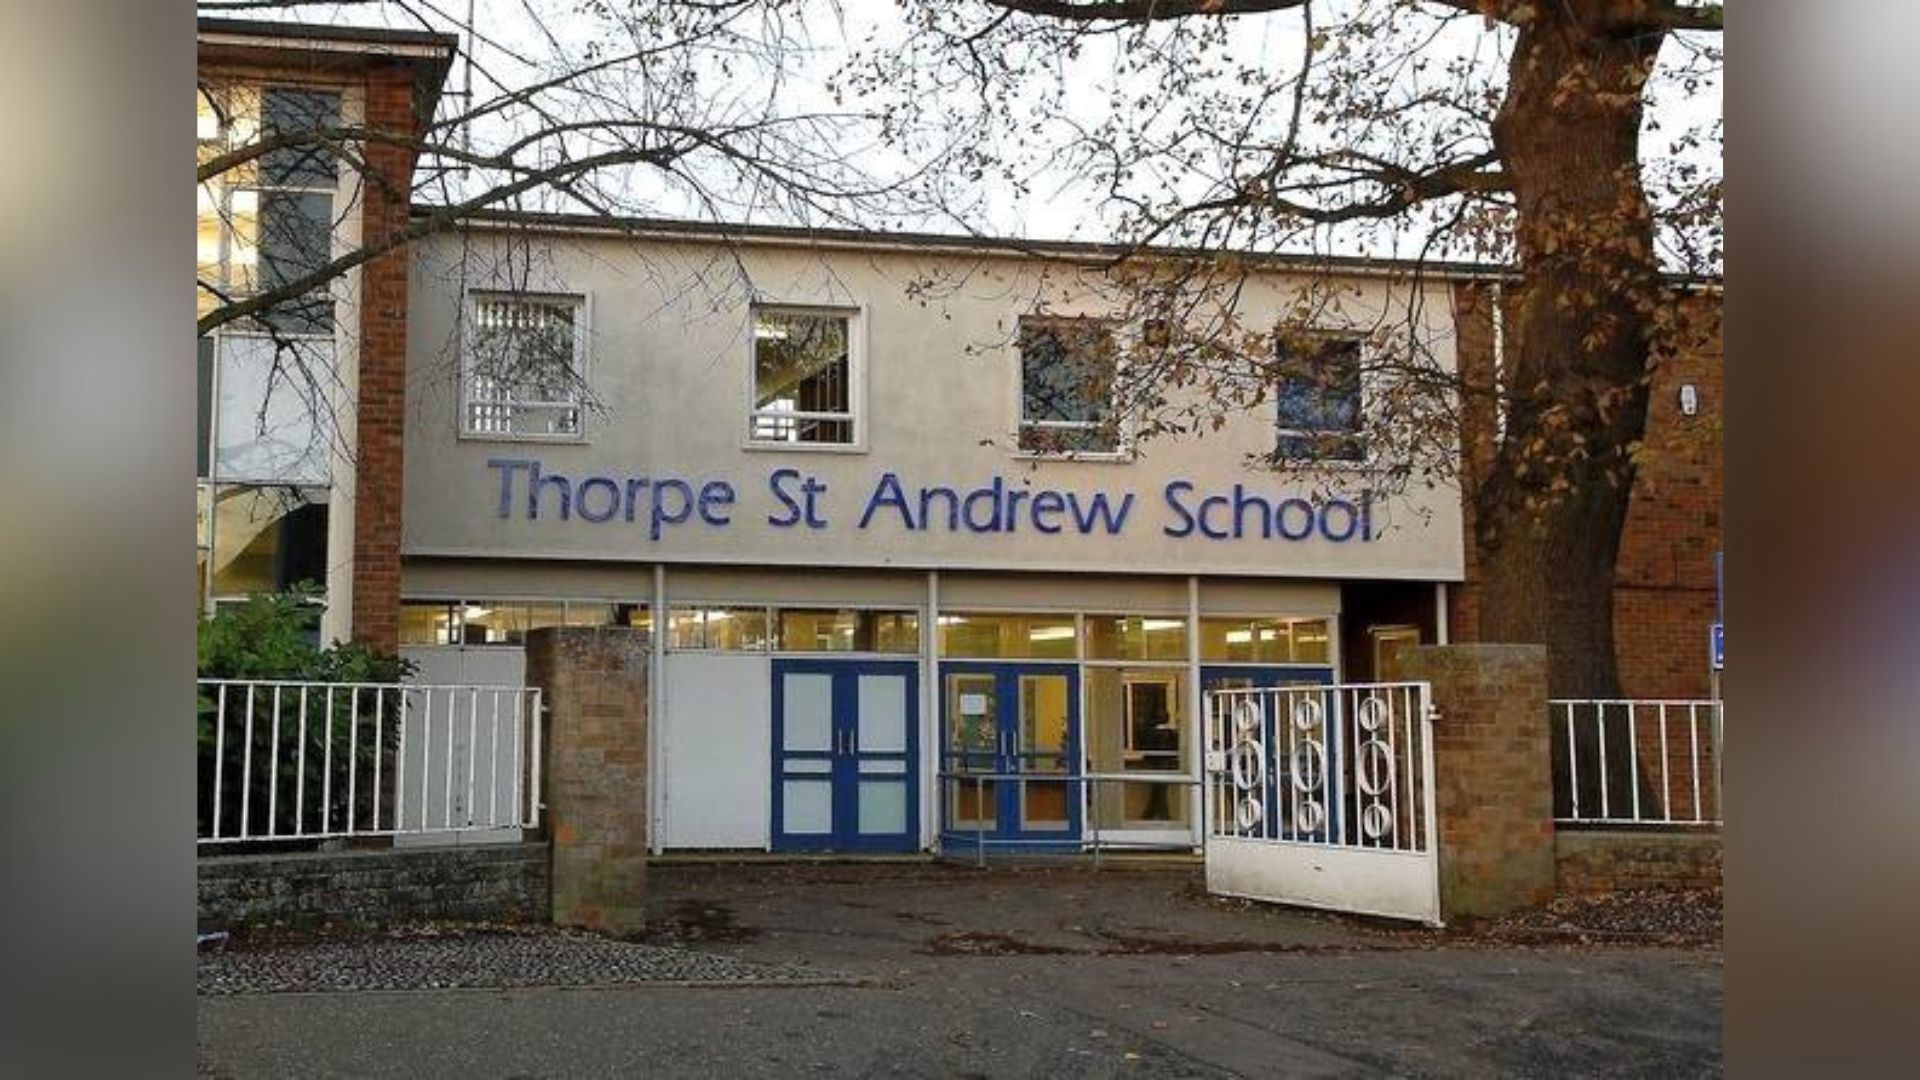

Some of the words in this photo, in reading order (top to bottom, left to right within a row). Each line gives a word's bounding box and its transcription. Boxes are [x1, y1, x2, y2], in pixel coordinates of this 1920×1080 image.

[488, 459, 735, 541] Thorpe
[768, 469, 828, 528] St
[858, 472, 1135, 535] Andrew
[1163, 481, 1372, 543] School
